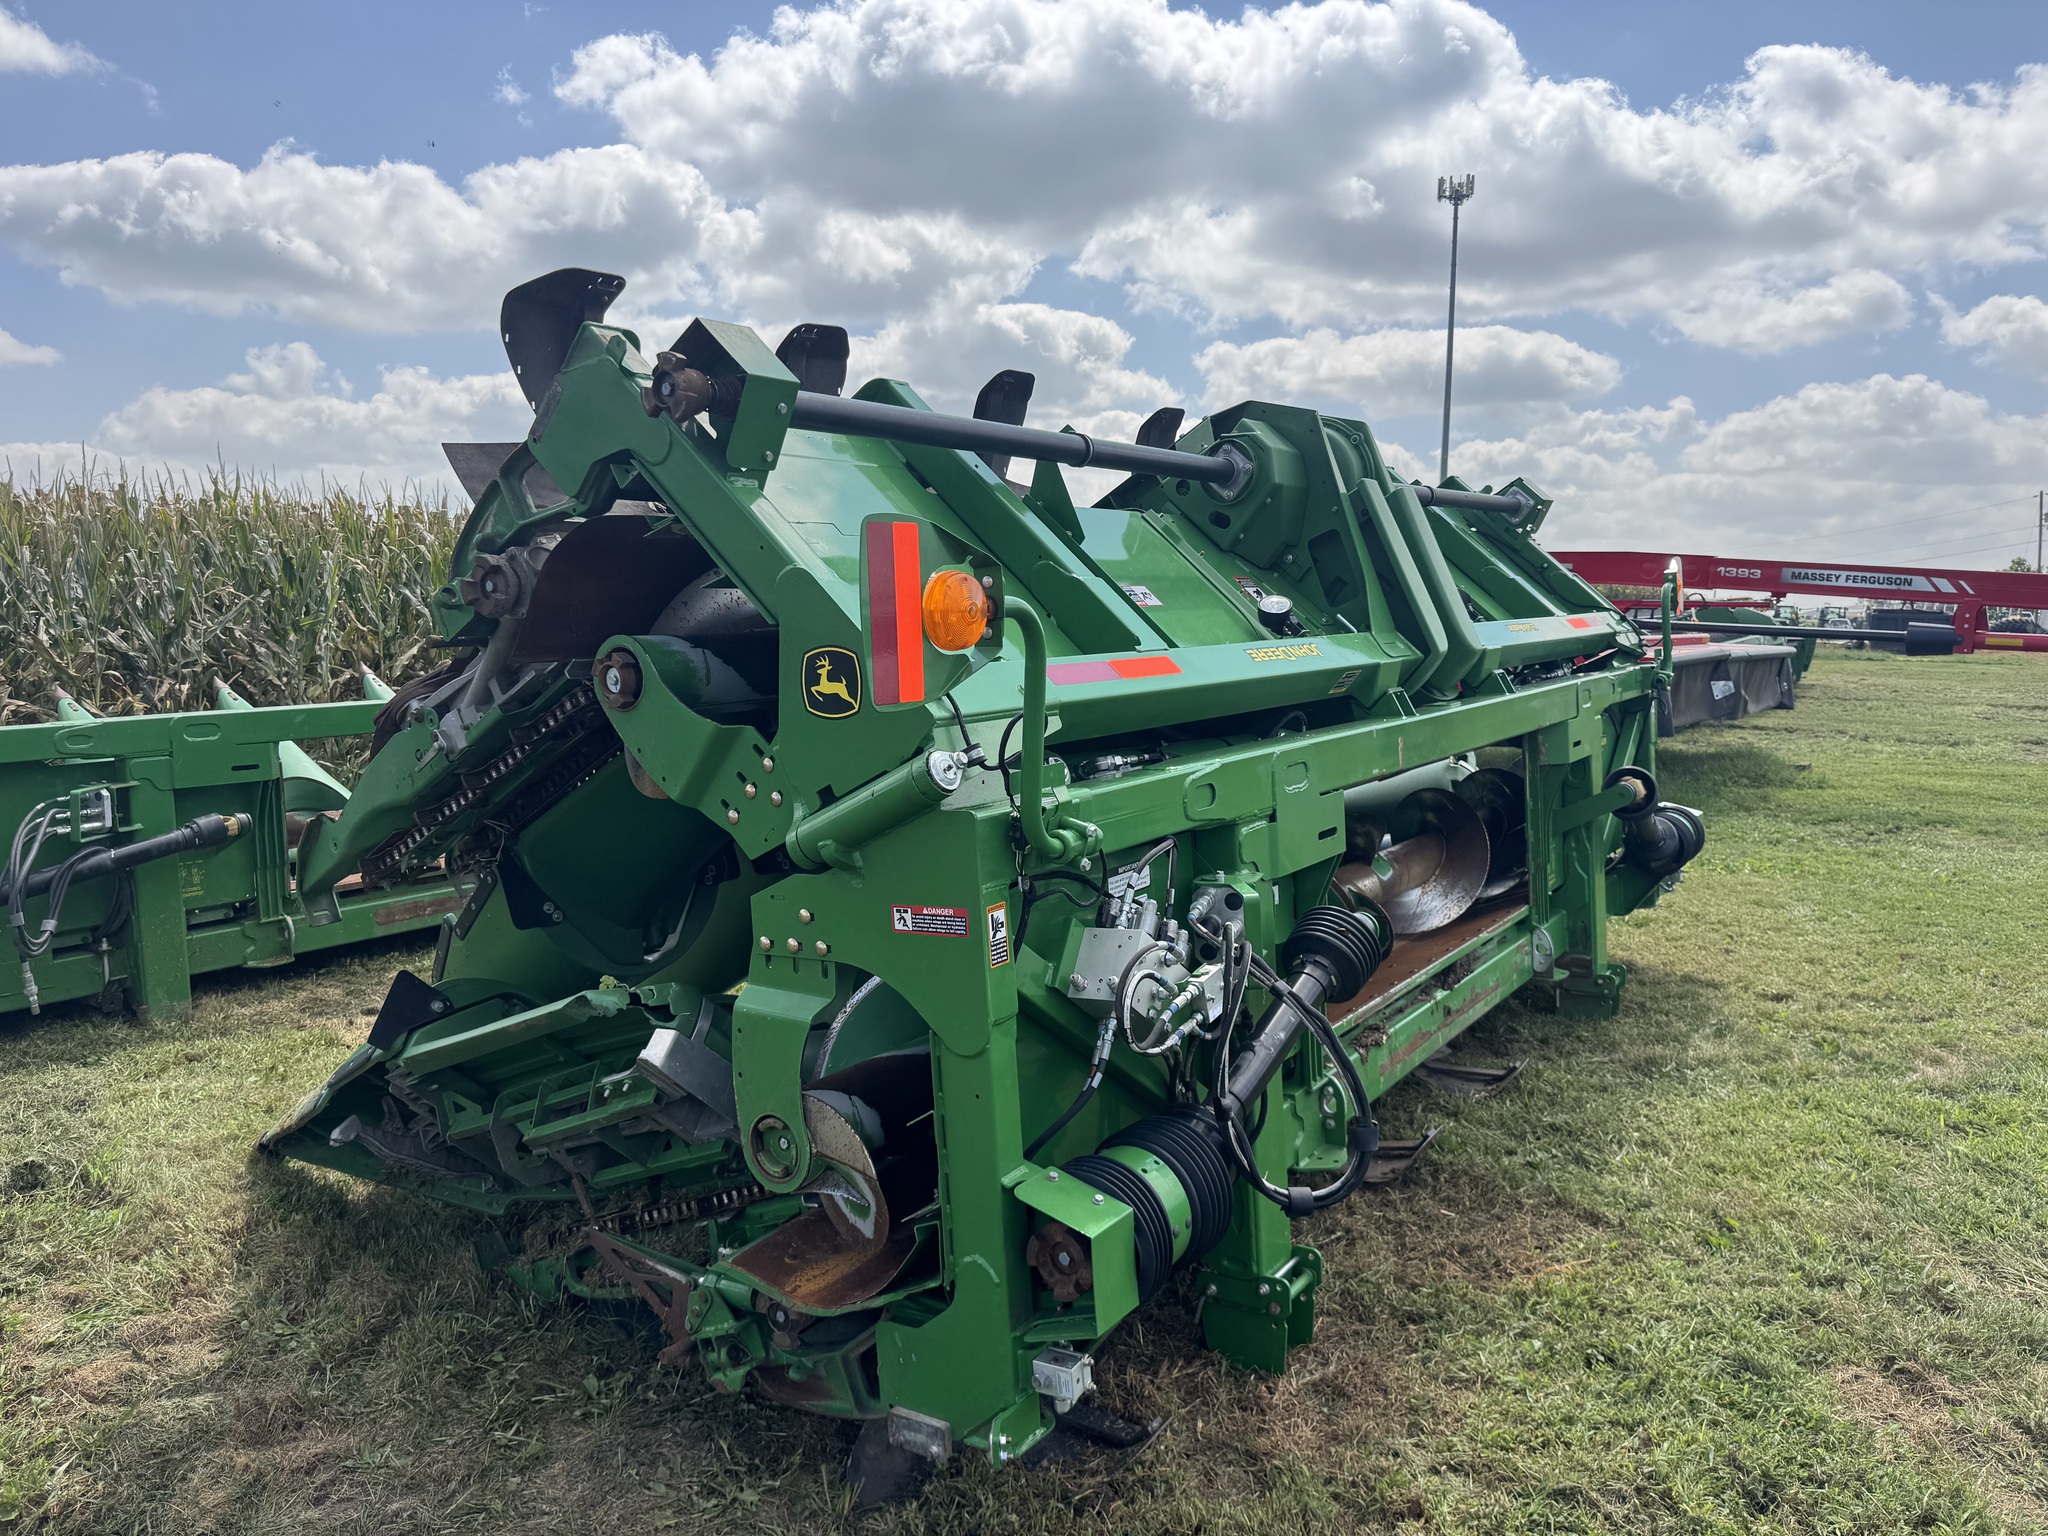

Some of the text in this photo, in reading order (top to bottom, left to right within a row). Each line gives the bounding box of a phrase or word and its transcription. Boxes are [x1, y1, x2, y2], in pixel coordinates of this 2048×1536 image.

[1716, 567, 1761, 579] 1393
[1790, 571, 1914, 587] MASSEY FERGUSON
[1243, 643, 1323, 662] JOHN DEERE
